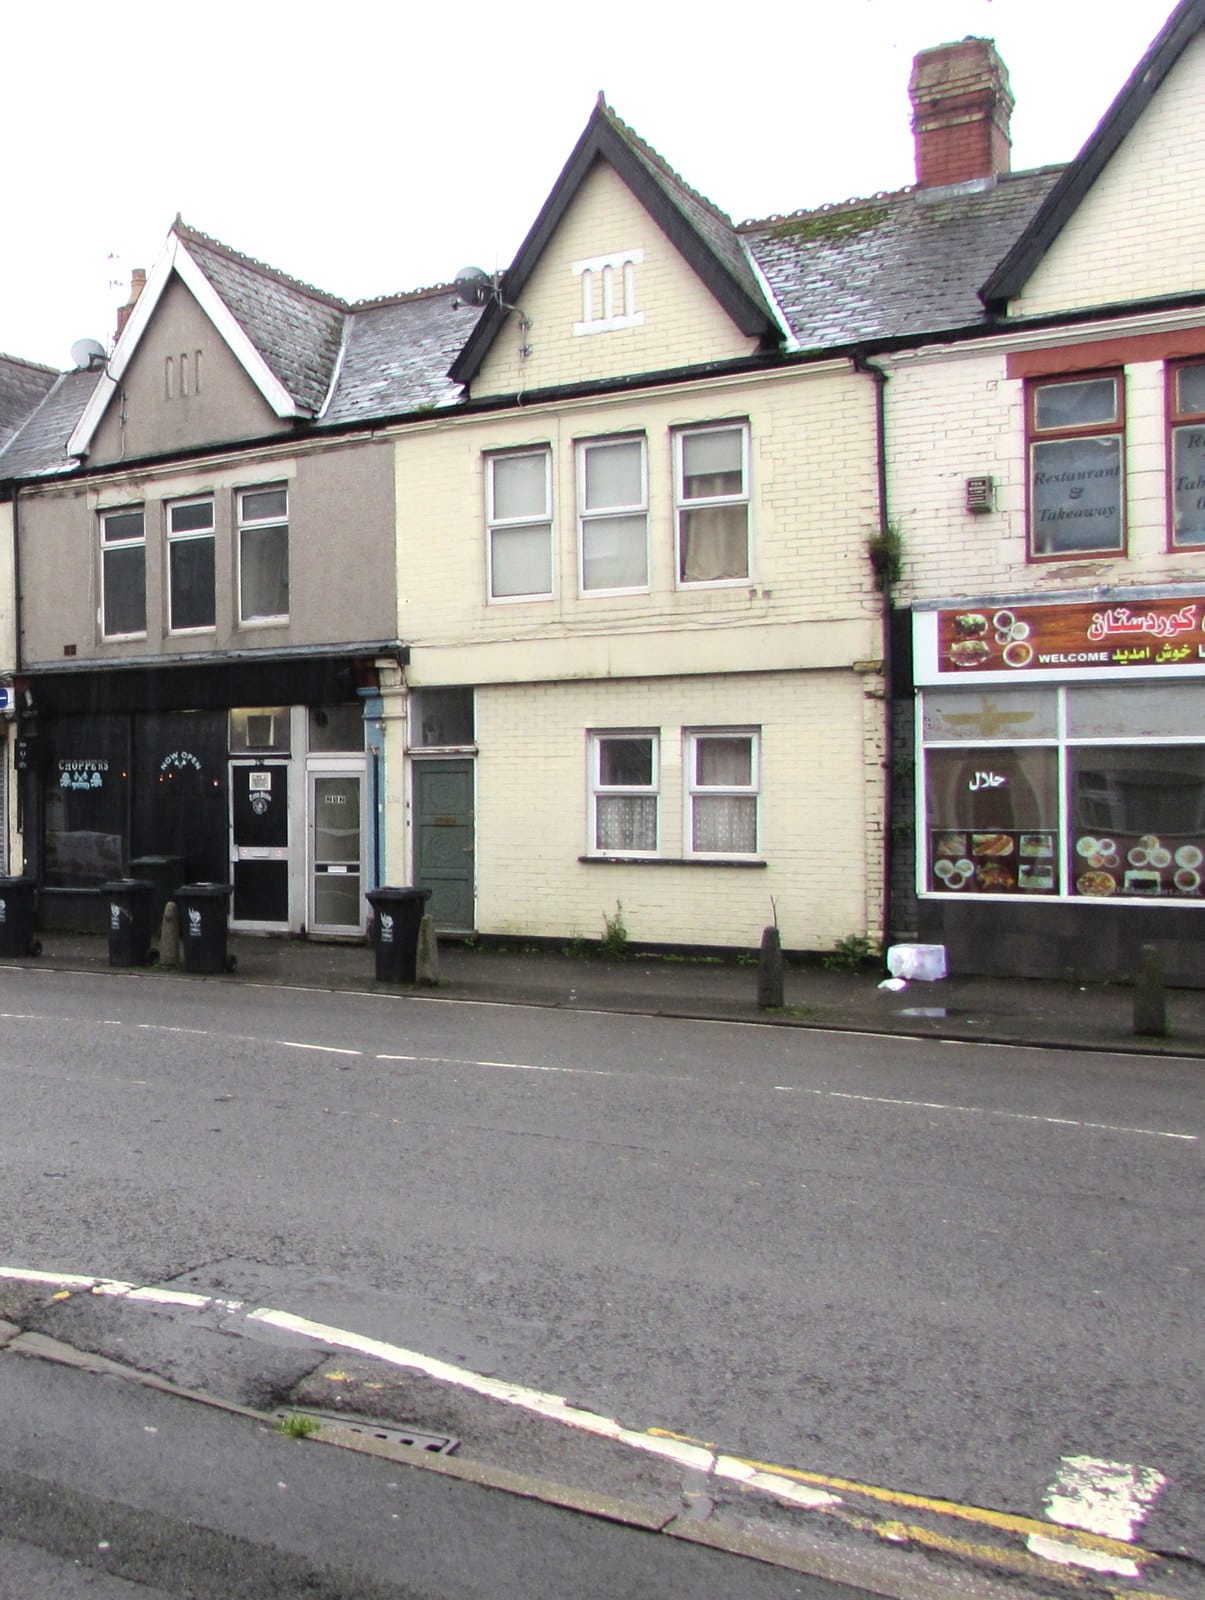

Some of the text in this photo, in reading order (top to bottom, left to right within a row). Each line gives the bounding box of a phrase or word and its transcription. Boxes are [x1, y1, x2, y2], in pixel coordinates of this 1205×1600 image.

[1034, 465, 1121, 485] Restaurant
[1068, 488, 1085, 500] &
[1038, 504, 1117, 523] Takeaway
[1038, 652, 1110, 664] WELCOME
[58, 759, 109, 771] CHOPPERS
[160, 750, 202, 771] NOW OPEN
[968, 771, 1006, 791] حلال
